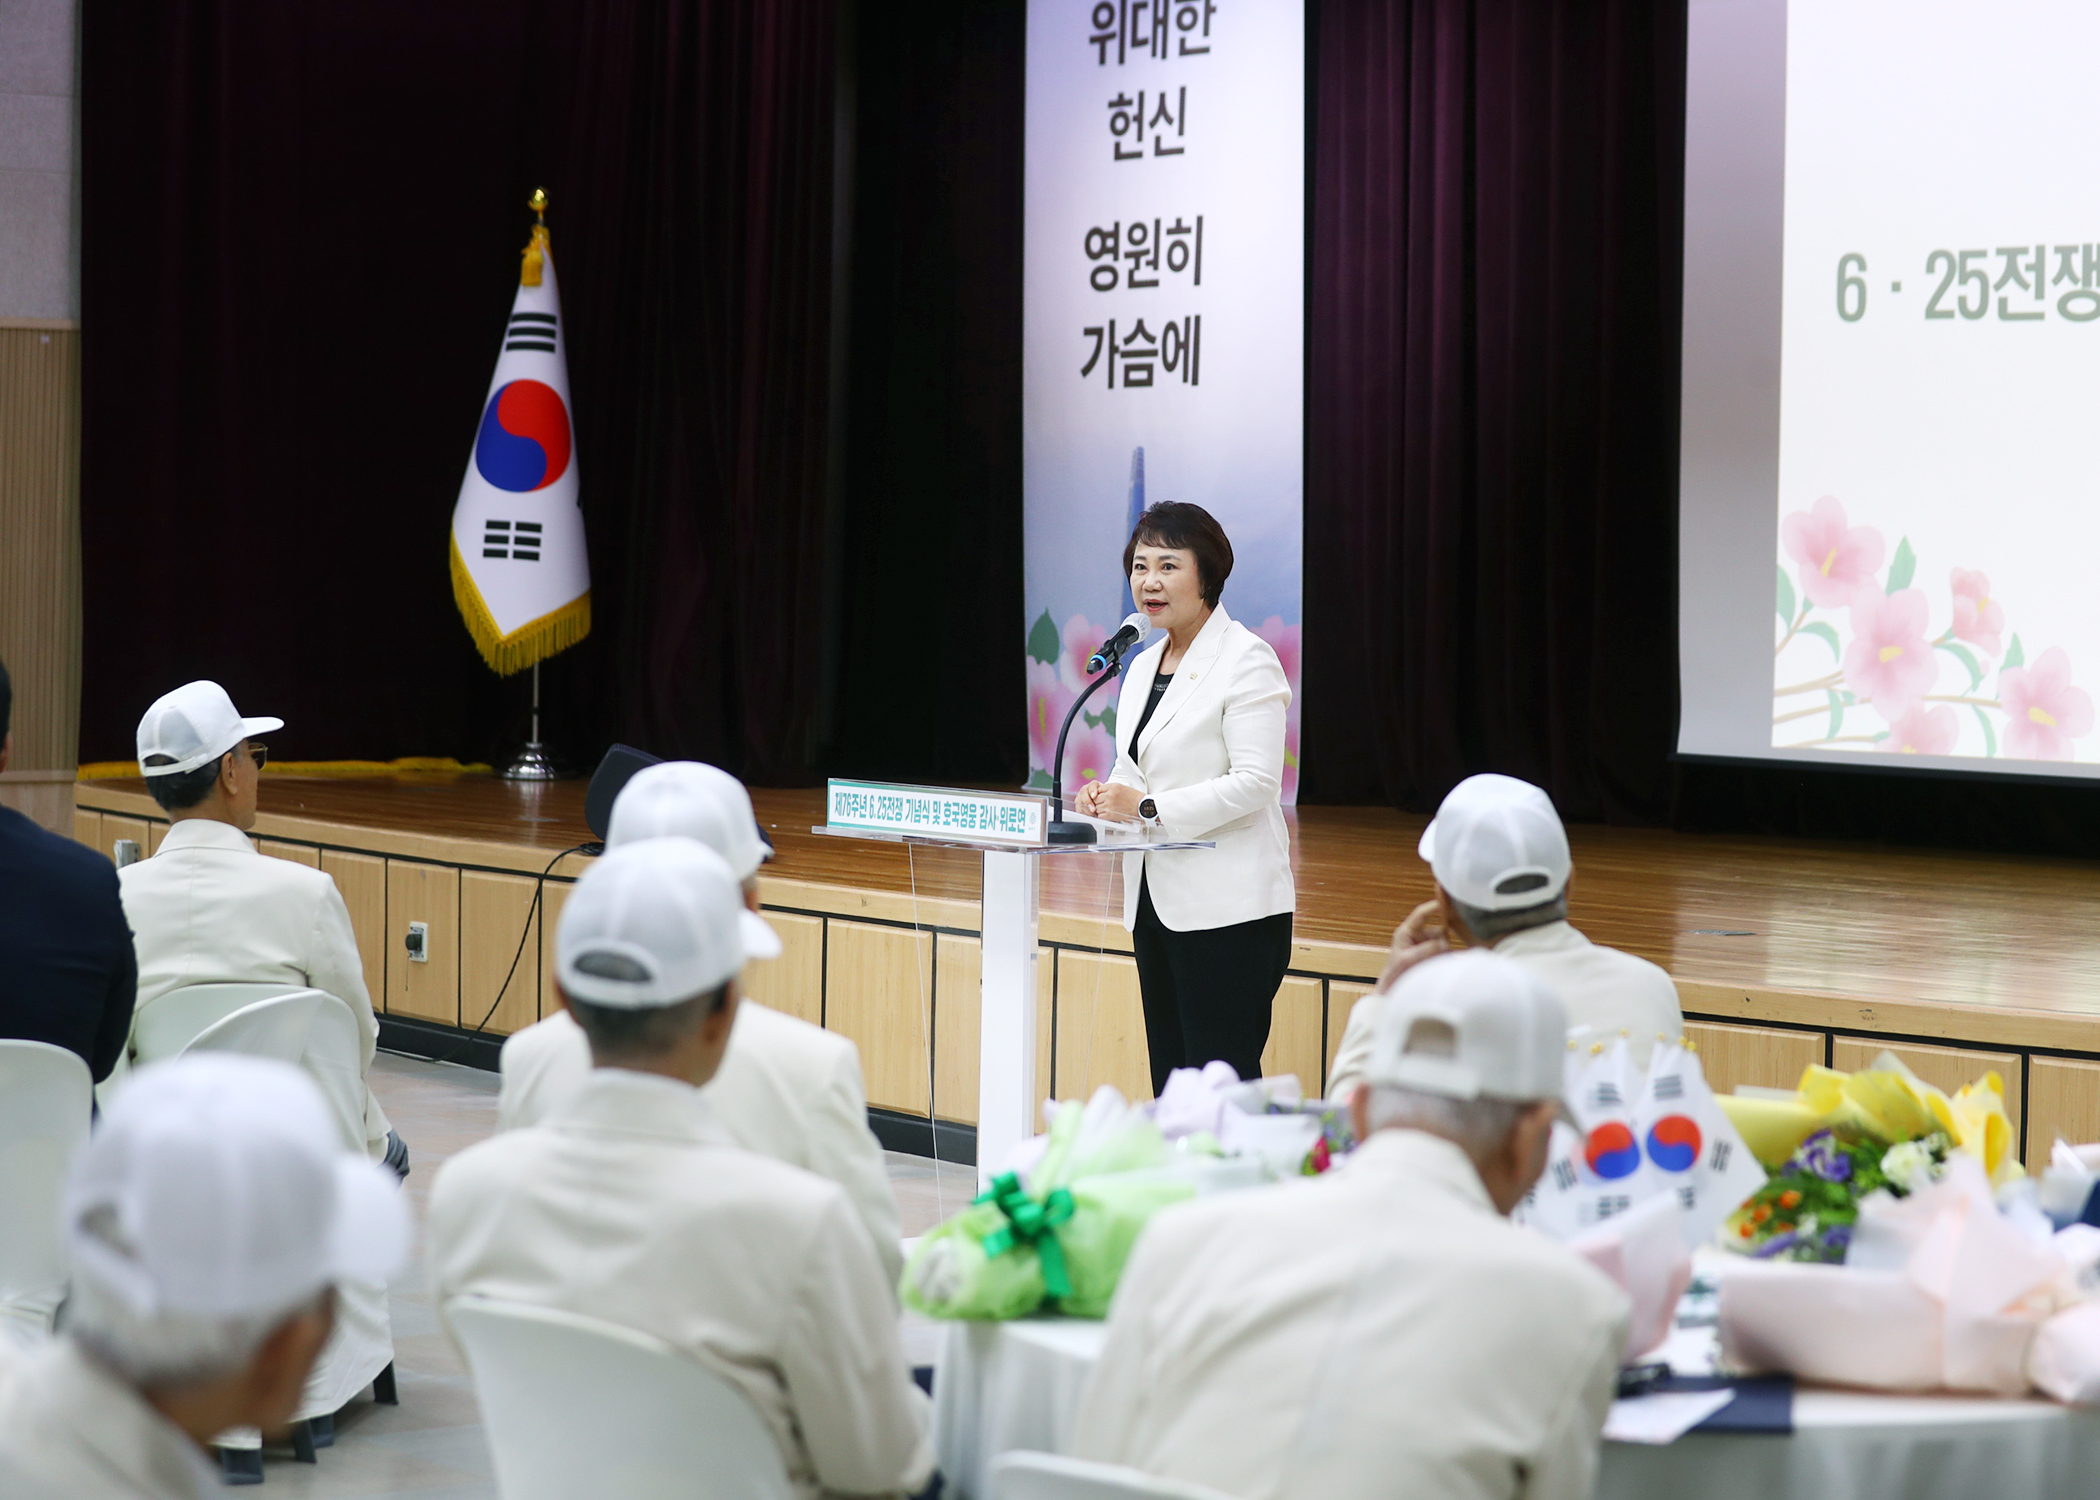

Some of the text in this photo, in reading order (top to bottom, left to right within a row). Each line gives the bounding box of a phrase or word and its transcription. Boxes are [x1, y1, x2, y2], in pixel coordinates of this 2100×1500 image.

[1089, 0, 1217, 66] 위대한
[1108, 86, 1187, 161] 헌신
[1084, 215, 1203, 292] 영원히
[1081, 314, 1201, 389] 가슴에
[835, 792, 867, 818] 제76주년
[905, 798, 931, 825] 기념식
[932, 801, 941, 825] 및
[943, 801, 977, 829] 호국영웅
